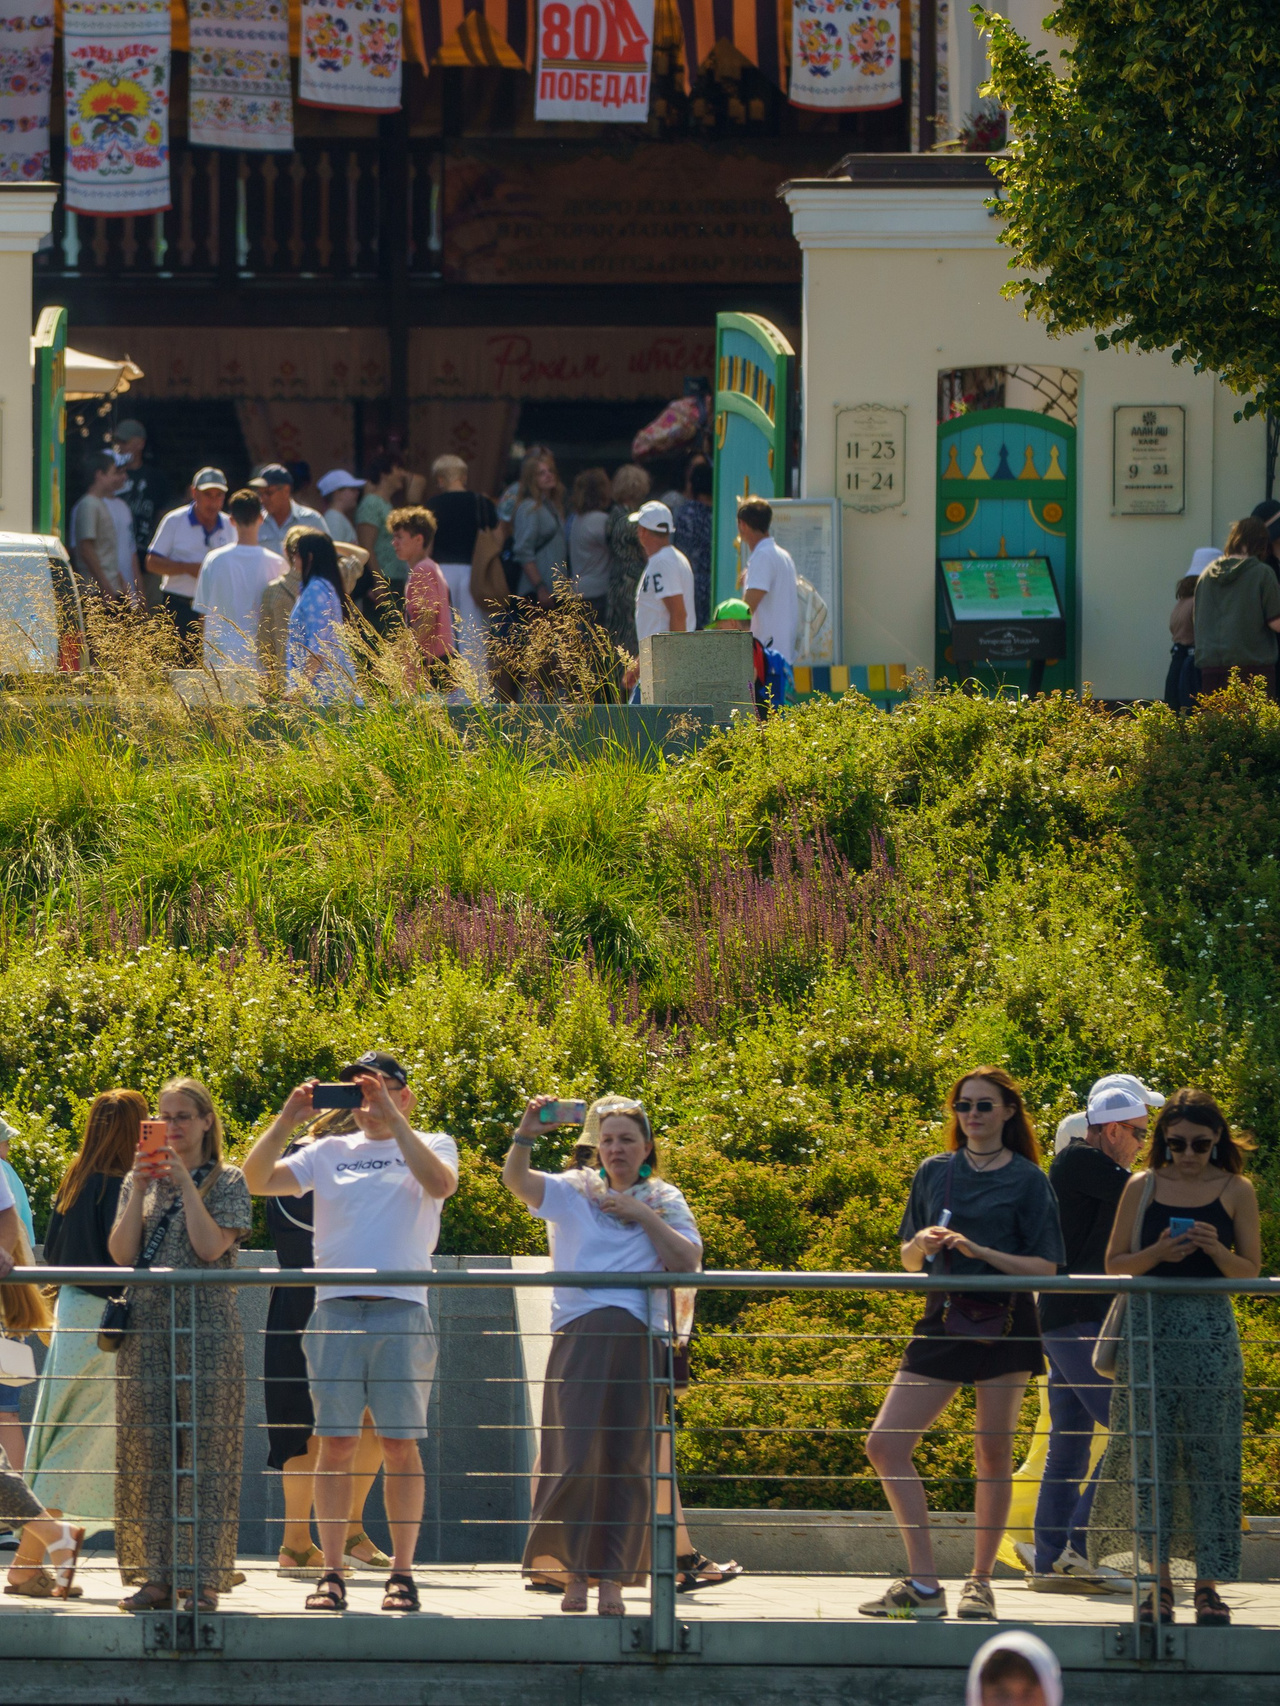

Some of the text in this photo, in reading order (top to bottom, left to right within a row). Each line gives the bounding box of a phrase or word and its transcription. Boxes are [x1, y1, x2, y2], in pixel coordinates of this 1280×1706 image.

[541, 2, 601, 60] 80
[539, 71, 648, 109] ПОБЕДА!
[845, 440, 896, 460] 11-23
[845, 471, 894, 491] 11-24
[336, 1158, 392, 1172] adidas
[143, 1226, 166, 1261] GUESS
